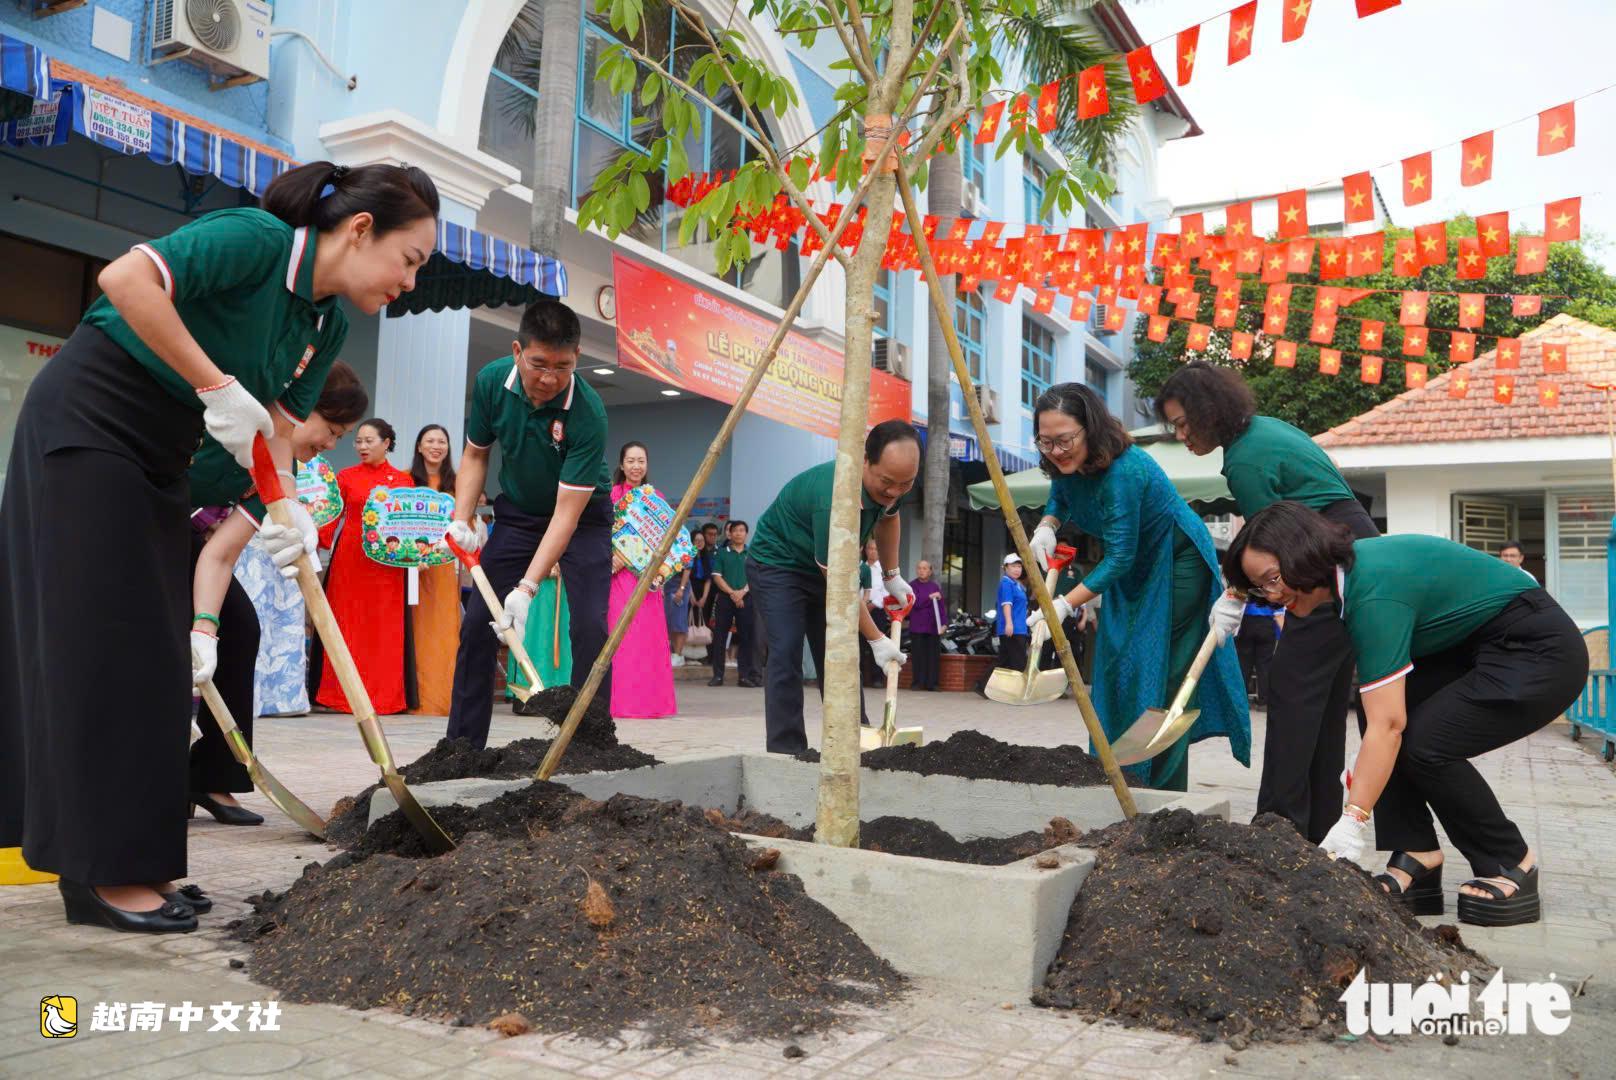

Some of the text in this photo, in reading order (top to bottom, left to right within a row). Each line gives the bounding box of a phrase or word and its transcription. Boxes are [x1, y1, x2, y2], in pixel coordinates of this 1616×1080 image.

[707, 330, 730, 358] LỄ
[778, 358, 819, 393] ĐỘNG
[385, 498, 447, 514] TÂN ĐỊNH
